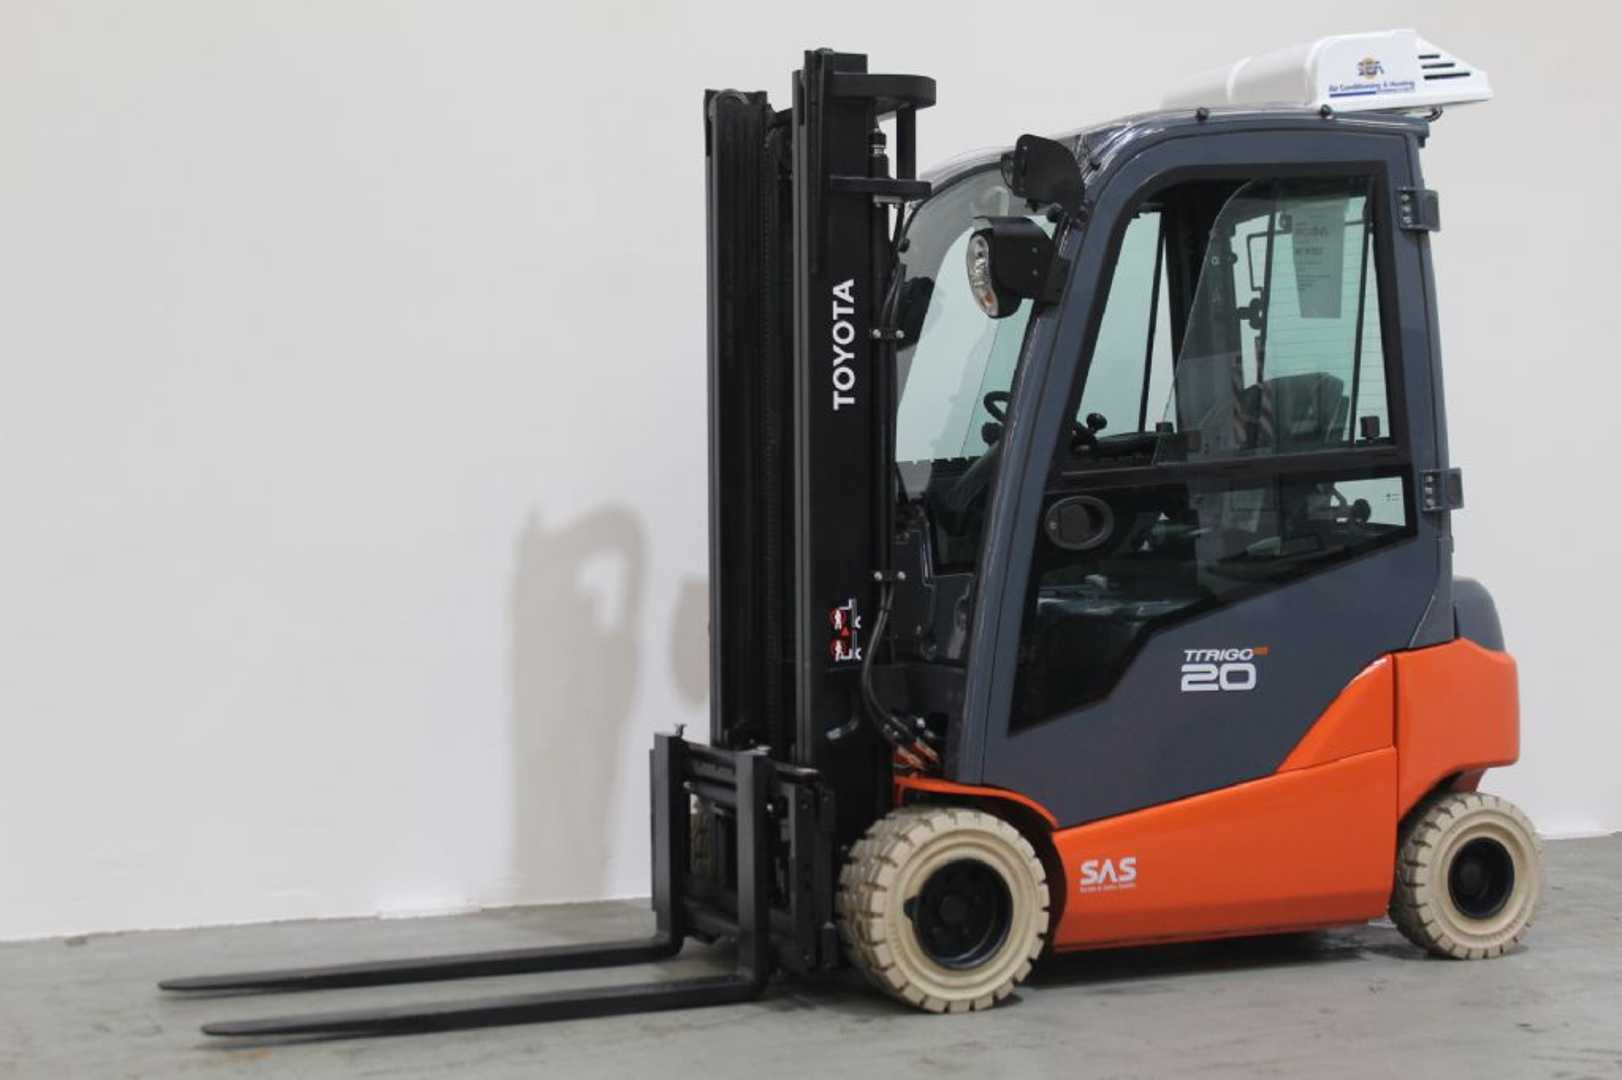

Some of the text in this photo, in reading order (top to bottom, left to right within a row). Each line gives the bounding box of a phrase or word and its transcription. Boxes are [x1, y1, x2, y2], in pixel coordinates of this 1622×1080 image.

[832, 278, 855, 411] TOYOTA
[1181, 663, 1257, 691] 20
[1080, 856, 1137, 886] SAS
